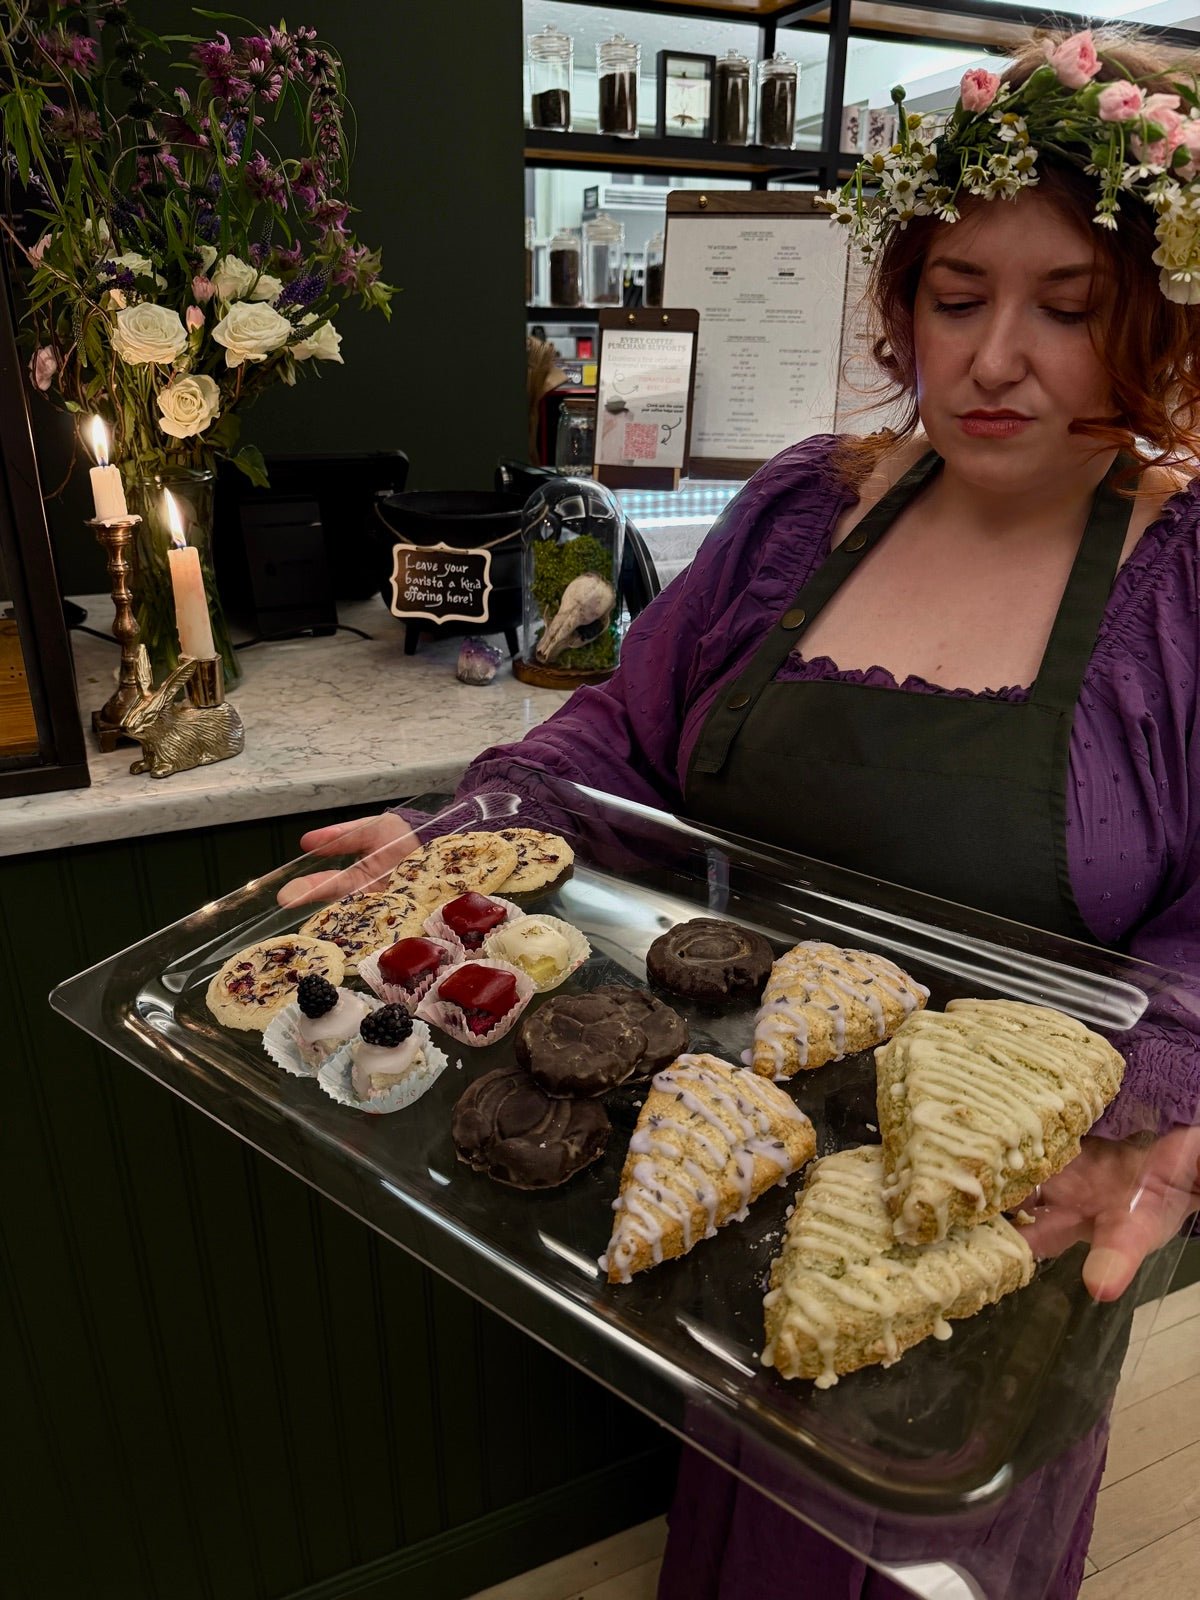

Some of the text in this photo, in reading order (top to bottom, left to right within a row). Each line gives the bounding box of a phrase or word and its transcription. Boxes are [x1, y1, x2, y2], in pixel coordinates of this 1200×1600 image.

[607, 342, 687, 352] PURCHASE SUPPORTS
[405, 554, 469, 577] Leave your
[405, 571, 443, 588] barista
[404, 586, 473, 607] offering here!
